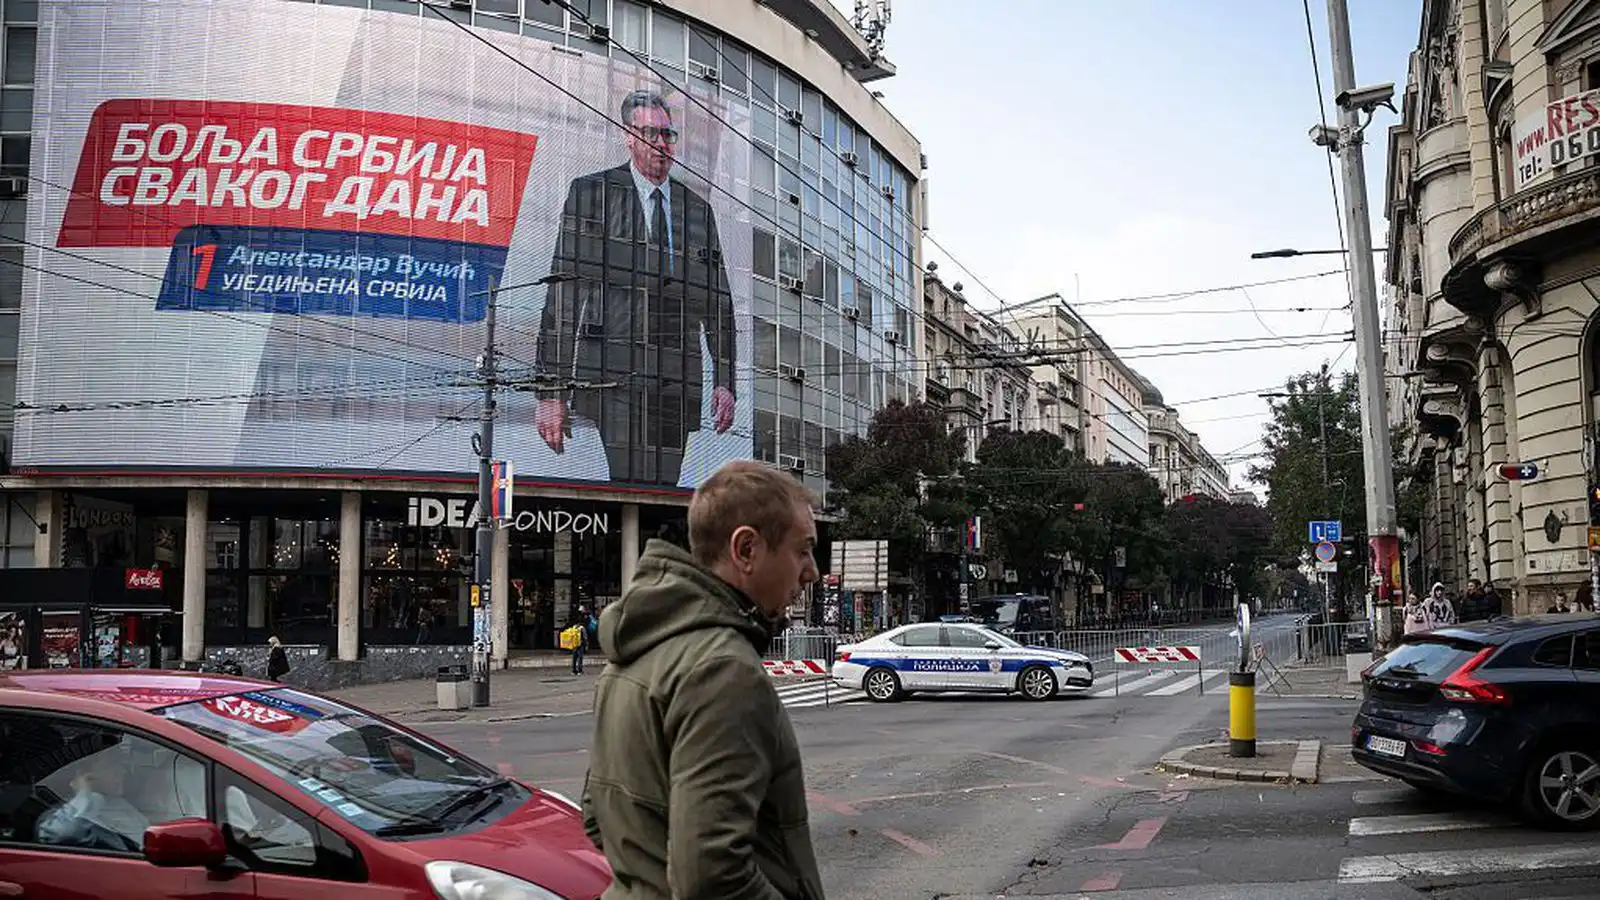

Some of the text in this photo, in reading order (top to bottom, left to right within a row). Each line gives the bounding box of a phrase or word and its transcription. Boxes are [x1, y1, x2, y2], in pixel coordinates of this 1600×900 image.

[111, 122, 488, 185] БОЉА СРБИЈА
[1551, 127, 1600, 165] 060
[100, 166, 490, 226] СВАКОГ ДАНА
[190, 243, 219, 290] 1
[227, 245, 476, 282] Александар Вучић
[221, 272, 448, 303] УЈЕДИЊЕНА СРБИЈА
[913, 663, 980, 671] ПОЛИЦИЈА
